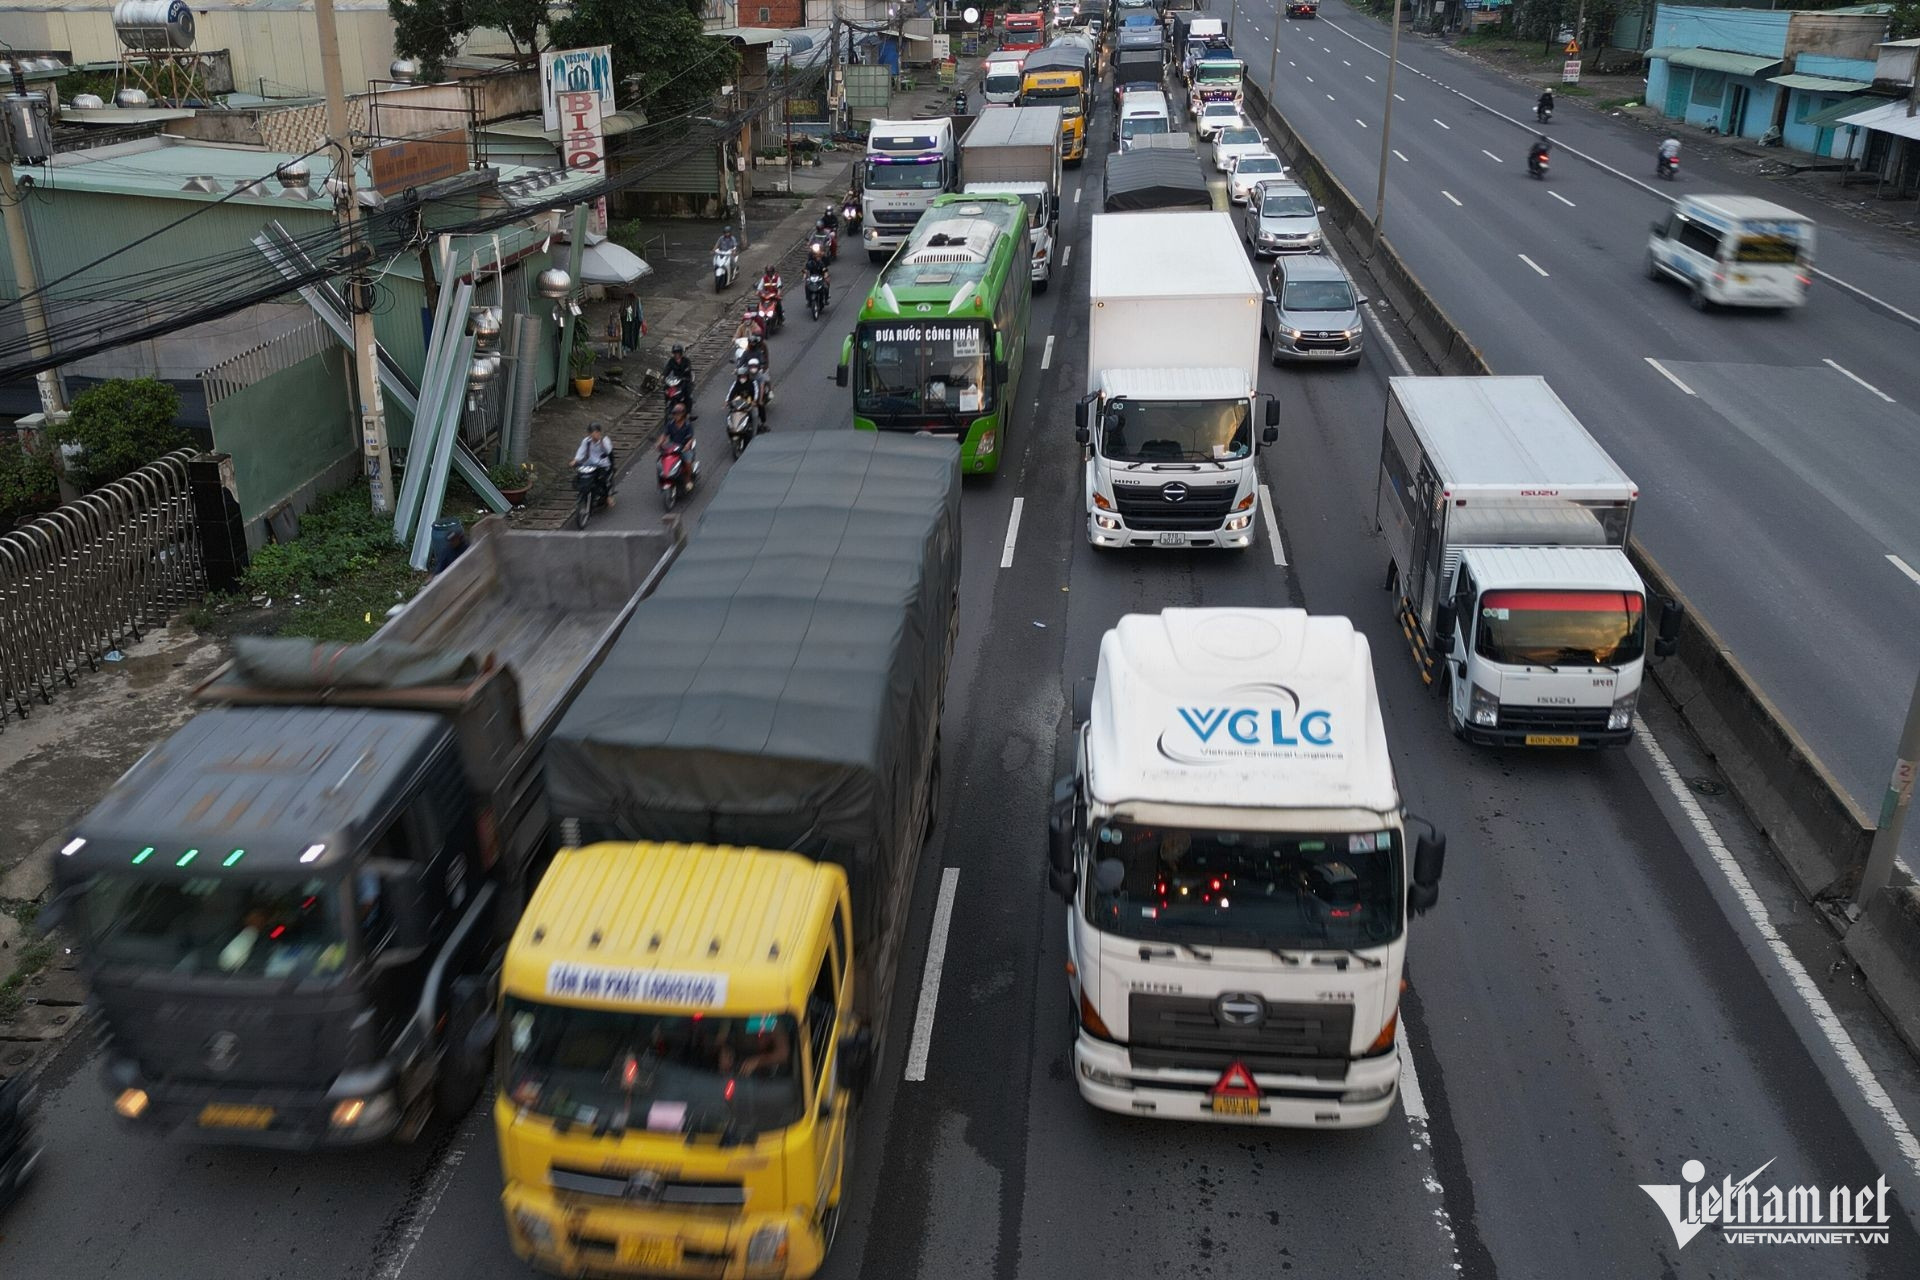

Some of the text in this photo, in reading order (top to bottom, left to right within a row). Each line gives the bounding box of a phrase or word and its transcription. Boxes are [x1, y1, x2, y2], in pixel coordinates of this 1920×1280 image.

[565, 52, 590, 64] VESTON
[925, 325, 951, 341] CÔNG
[952, 325, 980, 341] NHÂN
[1536, 696, 1576, 705] ISUZU
[1176, 706, 1335, 746] VCLC
